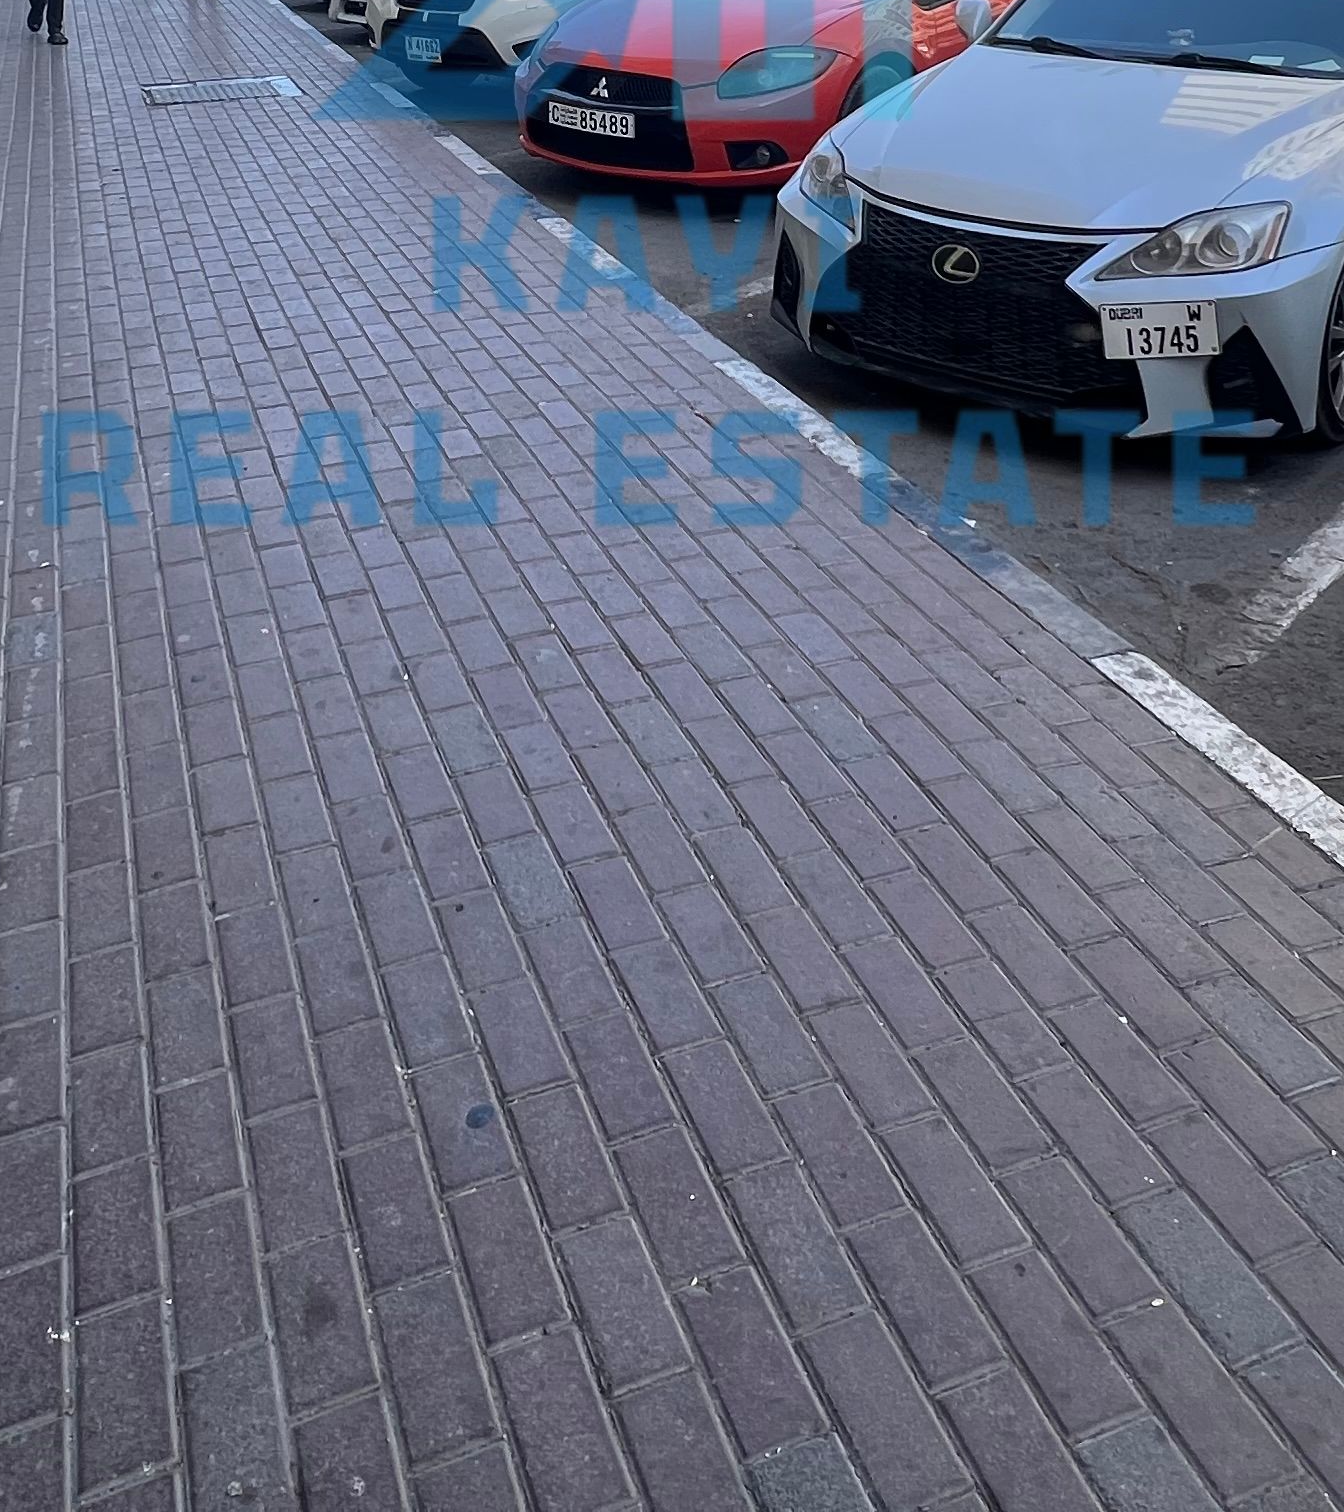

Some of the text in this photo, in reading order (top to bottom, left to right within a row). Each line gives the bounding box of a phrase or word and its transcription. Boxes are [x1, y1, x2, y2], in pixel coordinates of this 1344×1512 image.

[552, 105, 559, 122] C
[580, 110, 629, 135] 85489
[1186, 304, 1202, 321] W
[1126, 325, 1199, 356] 13745
